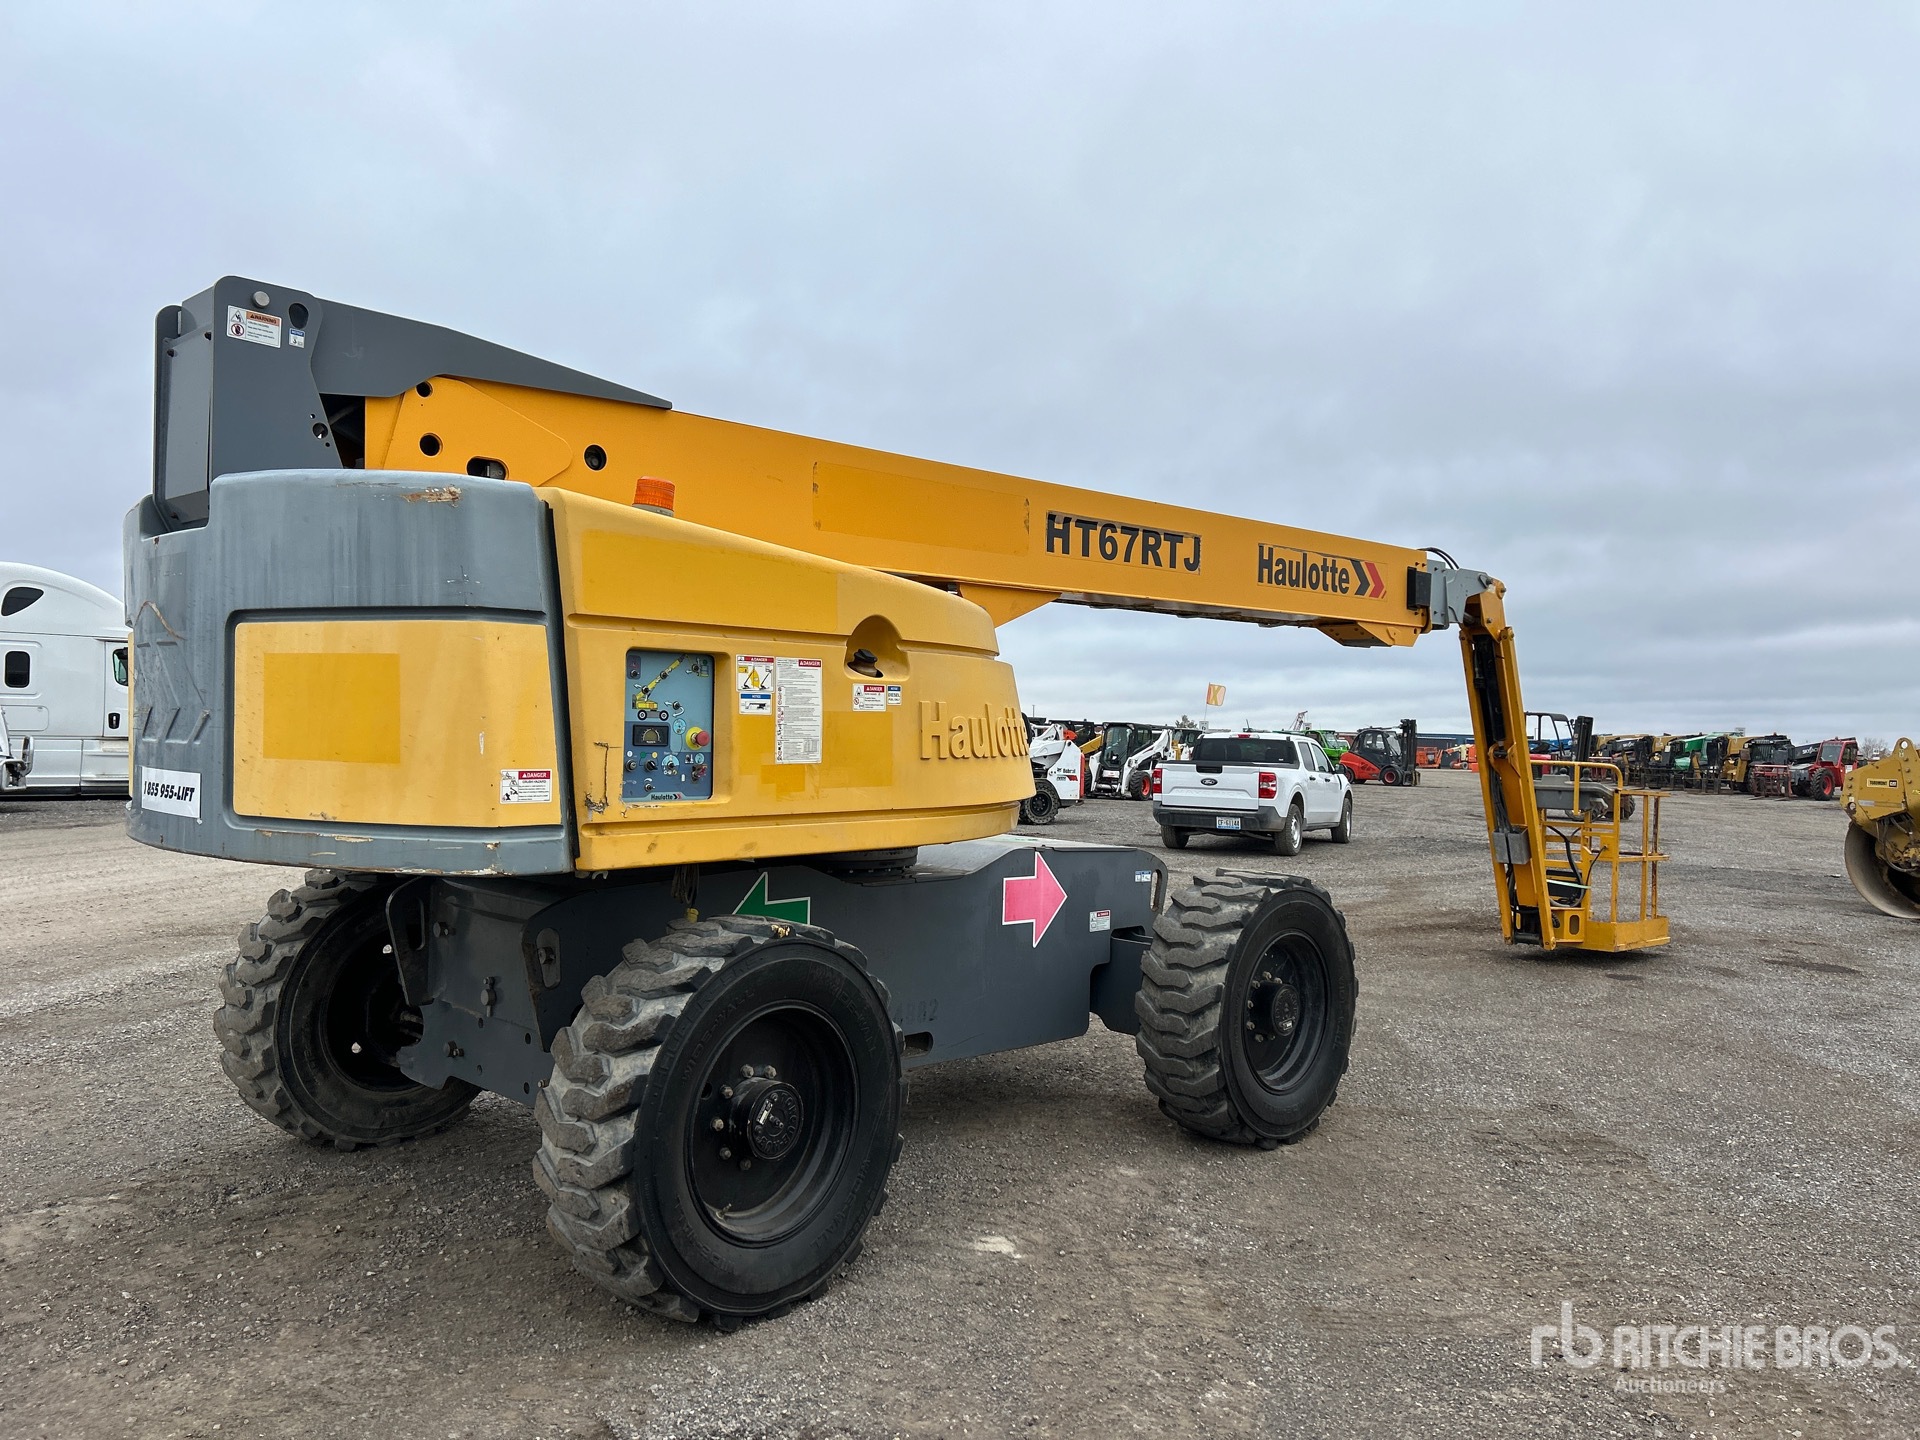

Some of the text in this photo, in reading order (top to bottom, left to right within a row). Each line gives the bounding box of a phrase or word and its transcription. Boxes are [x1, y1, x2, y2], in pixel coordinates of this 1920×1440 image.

[1046, 514, 1200, 573] HT67RTJ
[1258, 544, 1350, 595] Haulotte
[160, 784, 195, 802] 955-LIFT
